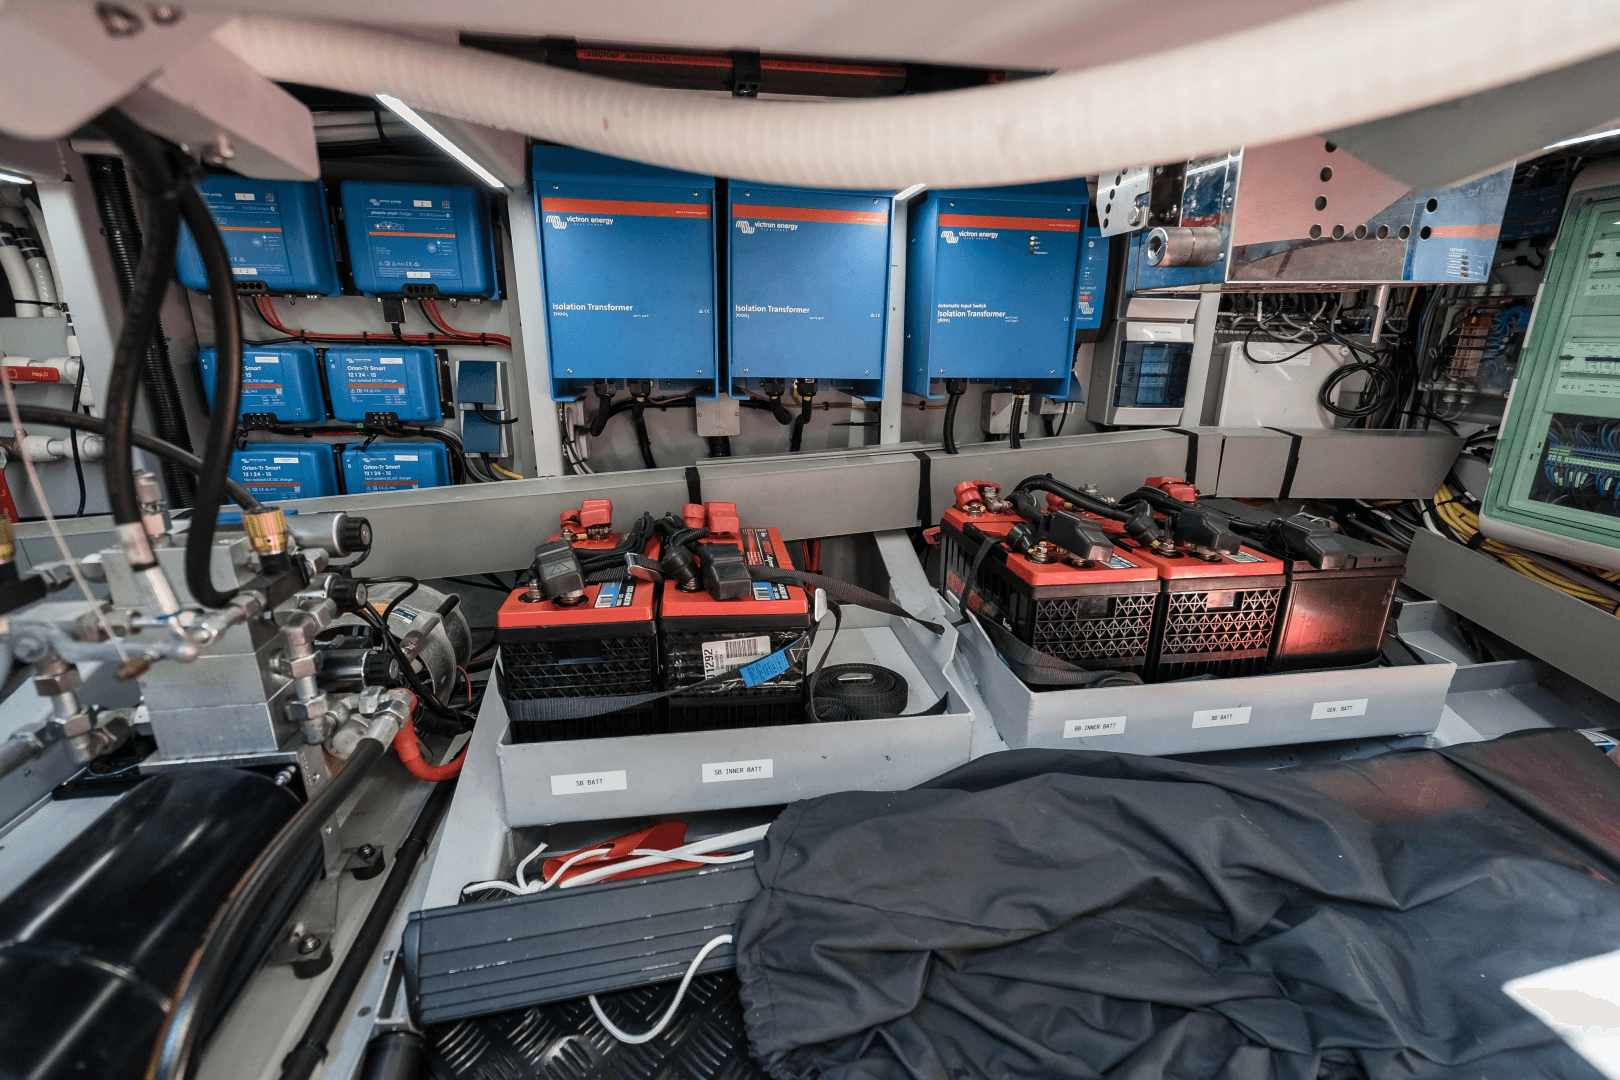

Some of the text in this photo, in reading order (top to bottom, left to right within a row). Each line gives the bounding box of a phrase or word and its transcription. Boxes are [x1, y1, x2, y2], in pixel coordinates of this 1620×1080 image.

[566, 215, 589, 223] victron
[755, 220, 776, 228] victron
[777, 223, 799, 231] energy
[979, 231, 999, 239] energy
[552, 302, 634, 311] Isolation Transformer
[735, 304, 810, 314] Isolation Transformer
[967, 310, 1006, 318] Transformer
[587, 778, 603, 786] BATT
